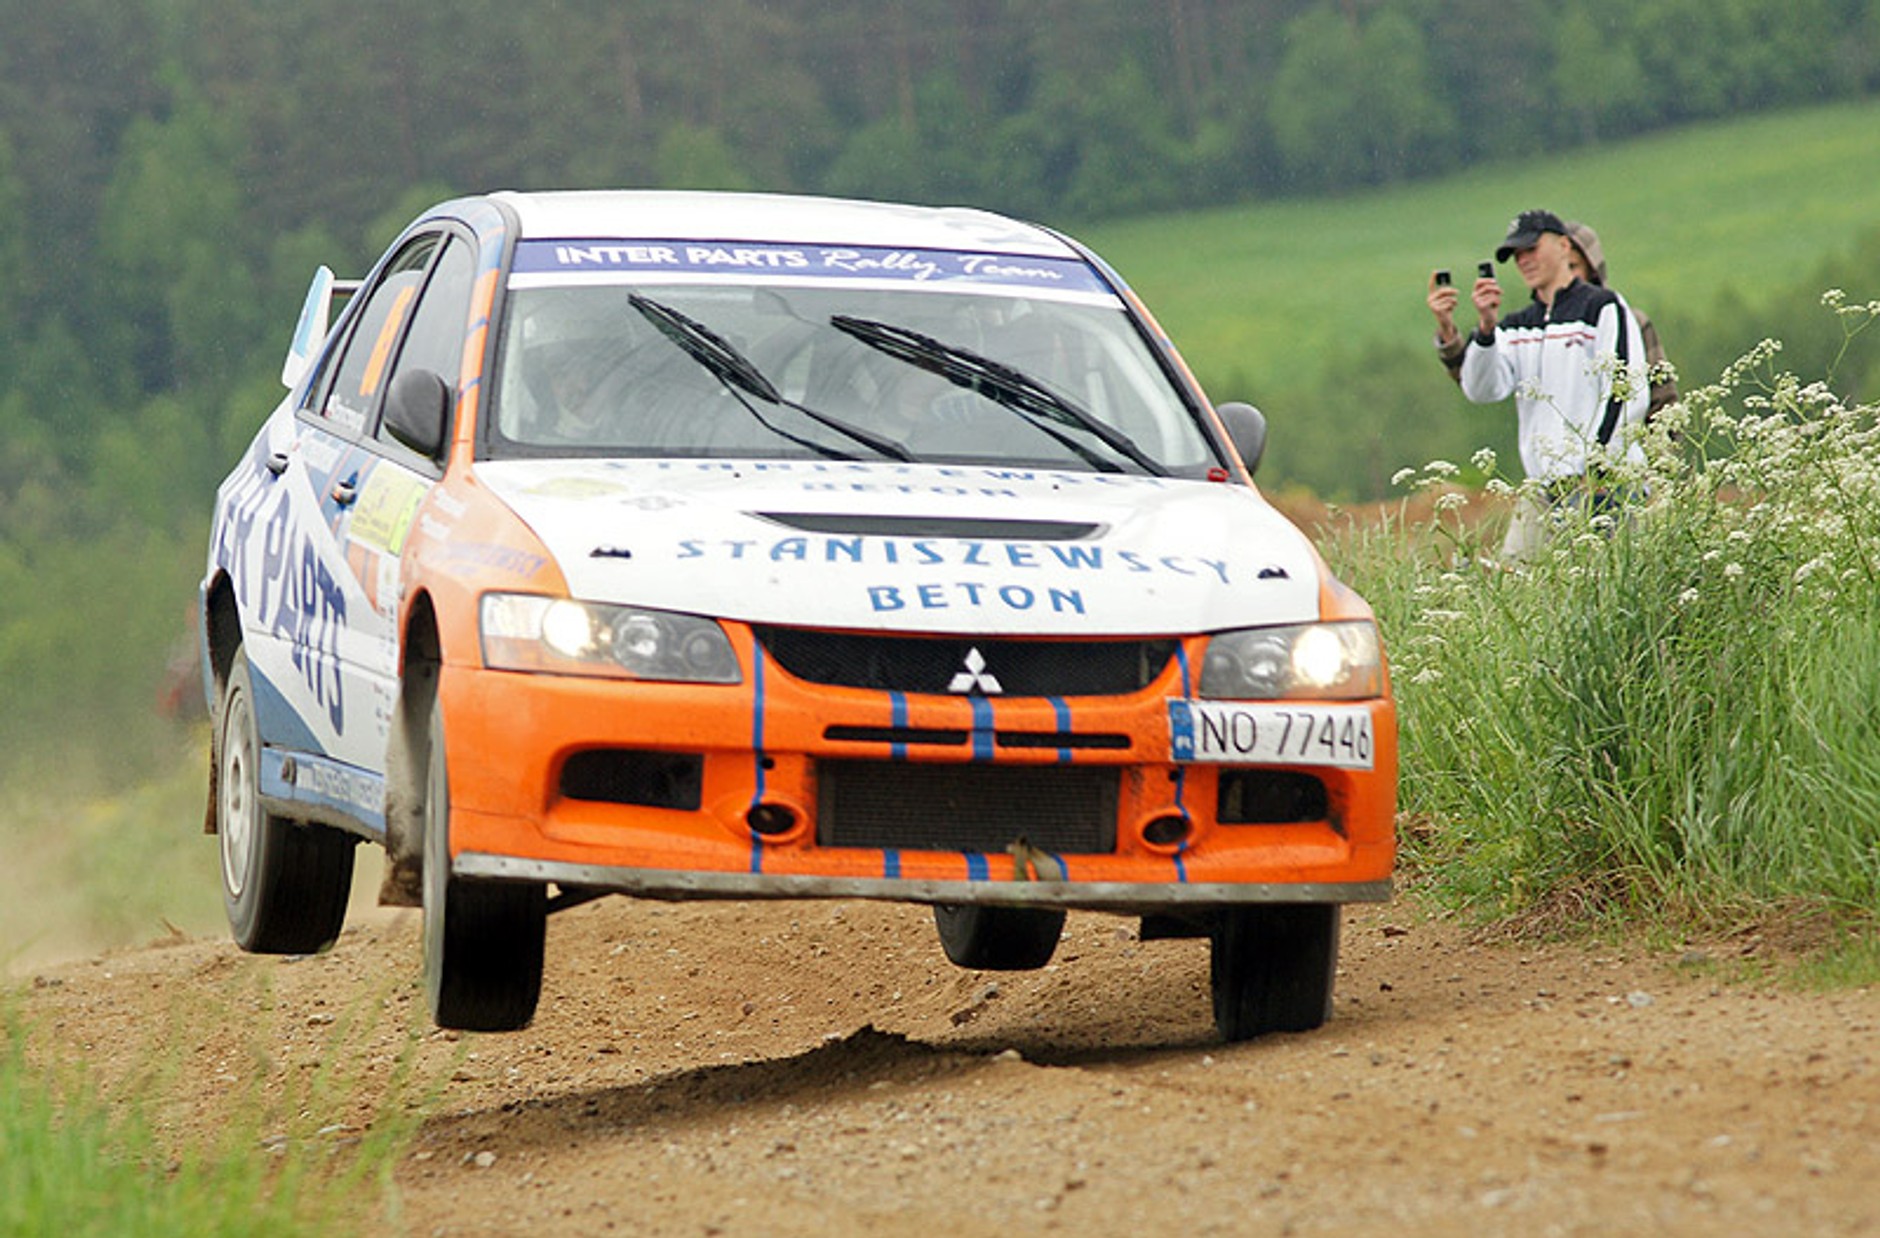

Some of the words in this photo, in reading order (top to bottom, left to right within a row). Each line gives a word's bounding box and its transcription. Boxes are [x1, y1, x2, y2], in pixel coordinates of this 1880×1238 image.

[555, 246, 680, 265] INTER
[685, 247, 809, 267] PARTS
[820, 250, 938, 281] Rally
[957, 256, 1063, 279] Team
[677, 537, 1230, 584] STANISZEWSCY
[867, 583, 1086, 614] BETON
[1201, 709, 1257, 753] NO
[1274, 712, 1370, 760] 77446
